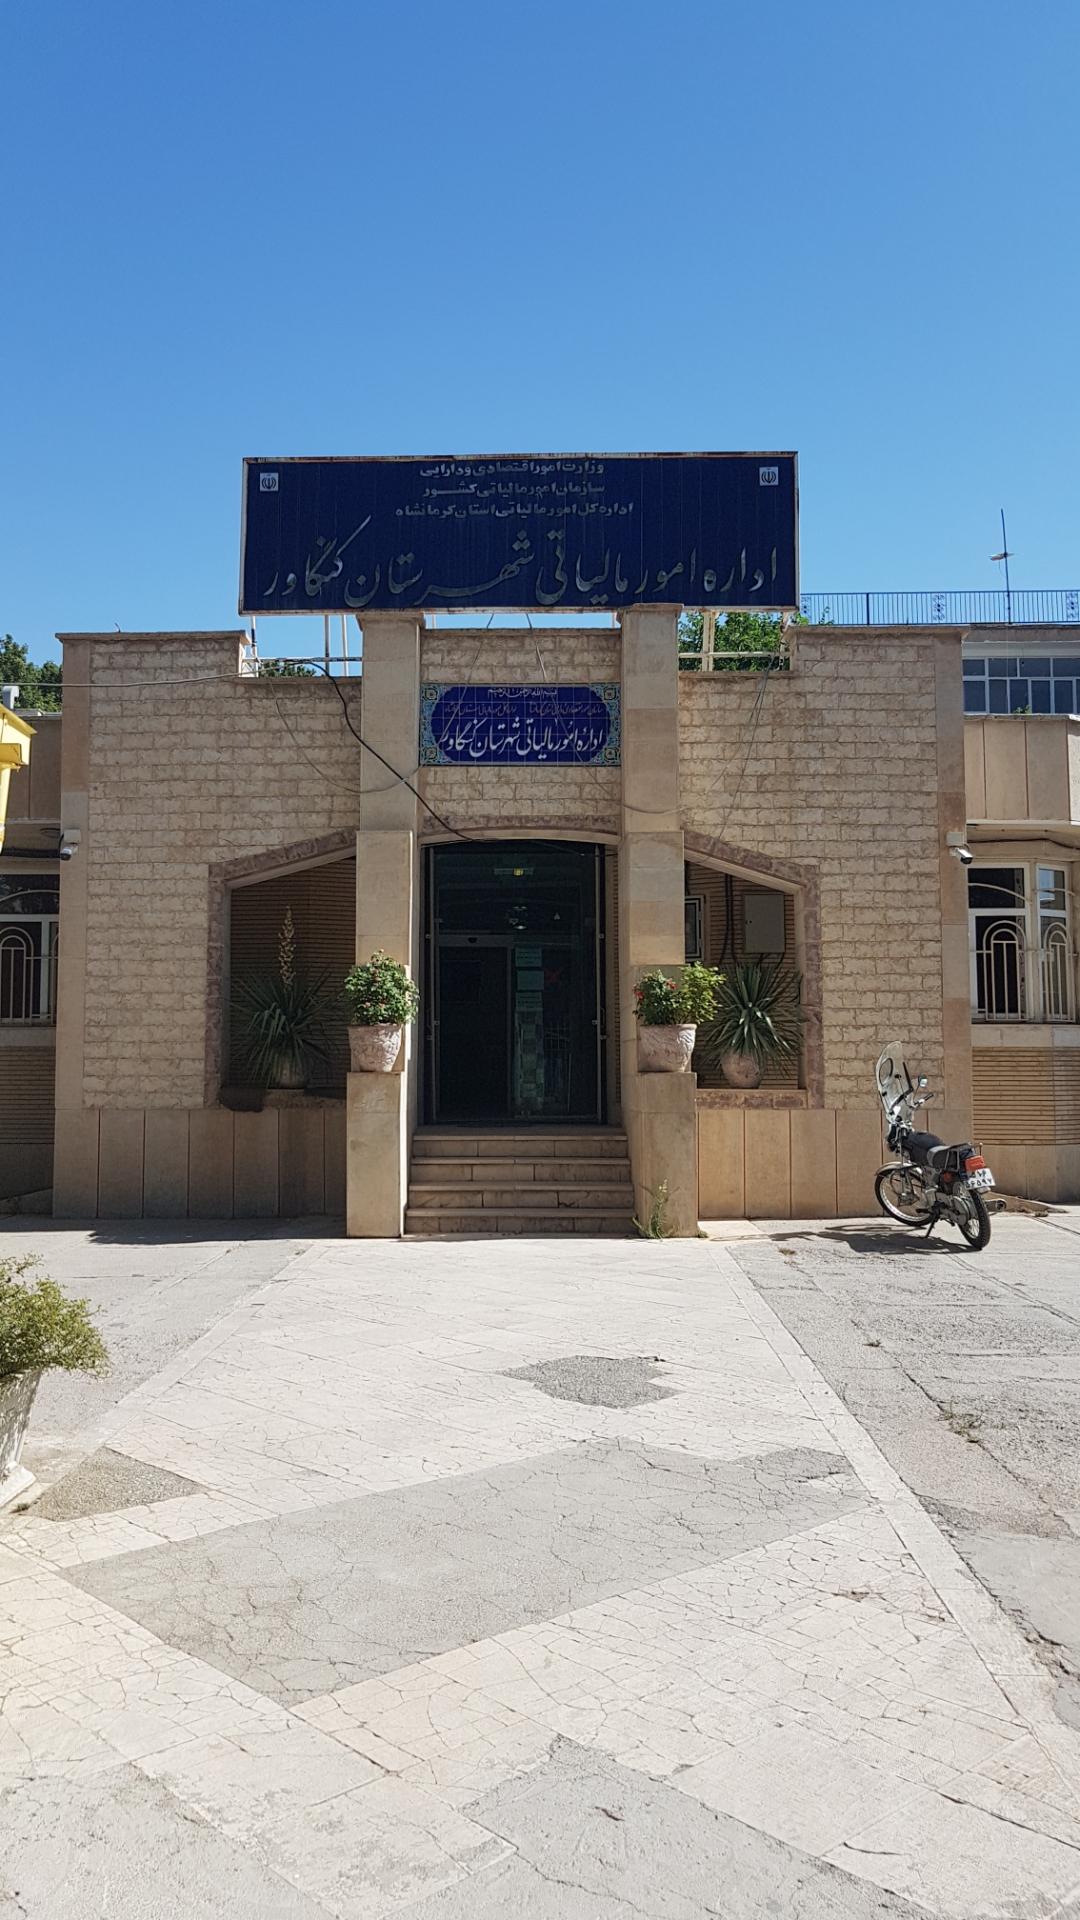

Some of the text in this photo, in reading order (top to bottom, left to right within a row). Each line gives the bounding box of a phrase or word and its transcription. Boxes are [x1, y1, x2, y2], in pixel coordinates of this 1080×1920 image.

[532, 461, 561, 475] امور
[562, 461, 604, 474] وزارت
[423, 481, 605, 498] سازمان امور مالیاتی کشور
[395, 502, 634, 519] اداره کل امور مالیاتی استان کرمانشاه
[263, 514, 777, 608] اداره امور مالیاتی شهرستان کنگاور
[440, 717, 488, 751] کنگاور
[469, 716, 520, 758] شهرستان
[516, 718, 553, 759] مالیاتی
